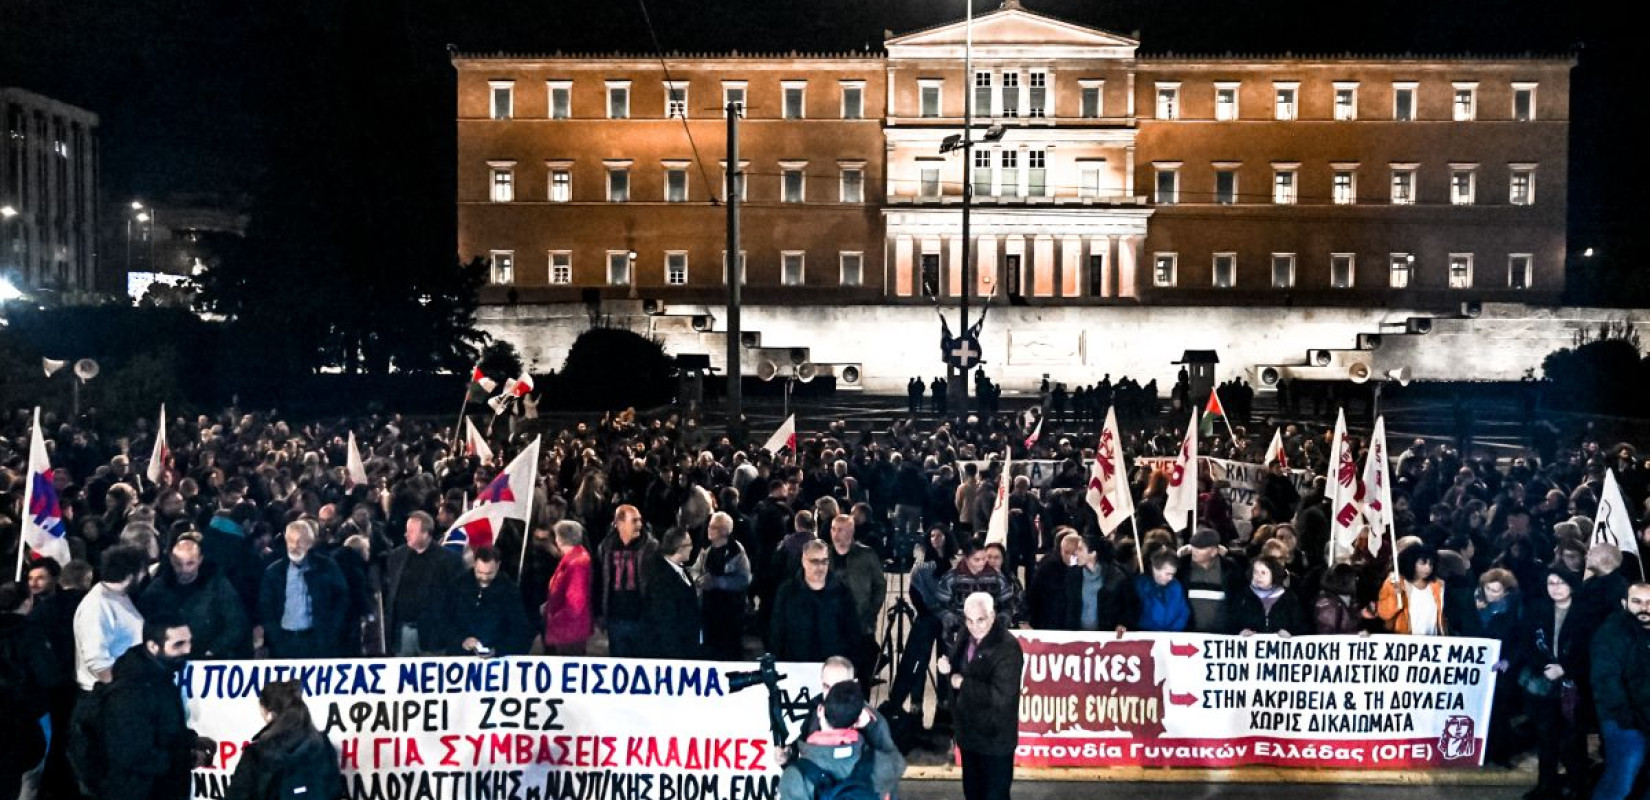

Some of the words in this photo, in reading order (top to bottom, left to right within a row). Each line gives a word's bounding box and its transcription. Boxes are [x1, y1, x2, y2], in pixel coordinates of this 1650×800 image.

[1202, 639, 1248, 660] ΣΤΗΝ
[1255, 640, 1340, 661] ΕΜΠΛΟΚΗ
[1348, 641, 1378, 661] ΤΗΣ
[1384, 642, 1442, 664] ΧΩΡΑΣ
[1448, 645, 1488, 665] ΜΑΣ
[397, 662, 509, 695] ΜΕΙΩΝΕΙ
[517, 662, 552, 693] ΤΟ
[561, 662, 724, 698] ΕΙΣΟΔΗΜΑ
[1205, 662, 1249, 682] ΣΤΟΝ
[1257, 663, 1399, 684] ΙΜΠΕΡΙΑΛΙΣΤΙΚΟ
[1406, 666, 1480, 686] ΠΟΛΕΜΟ
[1019, 687, 1079, 731] ύουμε
[1085, 687, 1158, 725] ενάντια
[1202, 689, 1247, 709] ΣΤΗΝ
[1252, 689, 1337, 711] ΑΚΡΙΒΕΙΑ
[1343, 692, 1357, 710] &
[1364, 691, 1384, 710] ΤΗ
[1390, 691, 1465, 711] ΔΟΥΛΕΙΑ
[326, 699, 448, 733] ΑΦΑΙΡΕΙ
[478, 697, 565, 732] ΖΩΕΣ
[1250, 711, 1302, 731] ΧΩΡΙΣ
[1308, 713, 1414, 733] ΔΙΚΑΙΩΜΑΤΑ
[374, 737, 424, 769] ΓΙΑ
[439, 734, 618, 768] ΣΥΜΒΑΣΕΙΣ
[626, 736, 769, 771] ΚΛΑΔΙΚΕΣ
[1015, 743, 1122, 760] σπονδία
[1130, 743, 1248, 760] Γυναικών
[1254, 740, 1364, 763] Ελλάδας
[1371, 743, 1434, 762] (ΟΓΕ)
